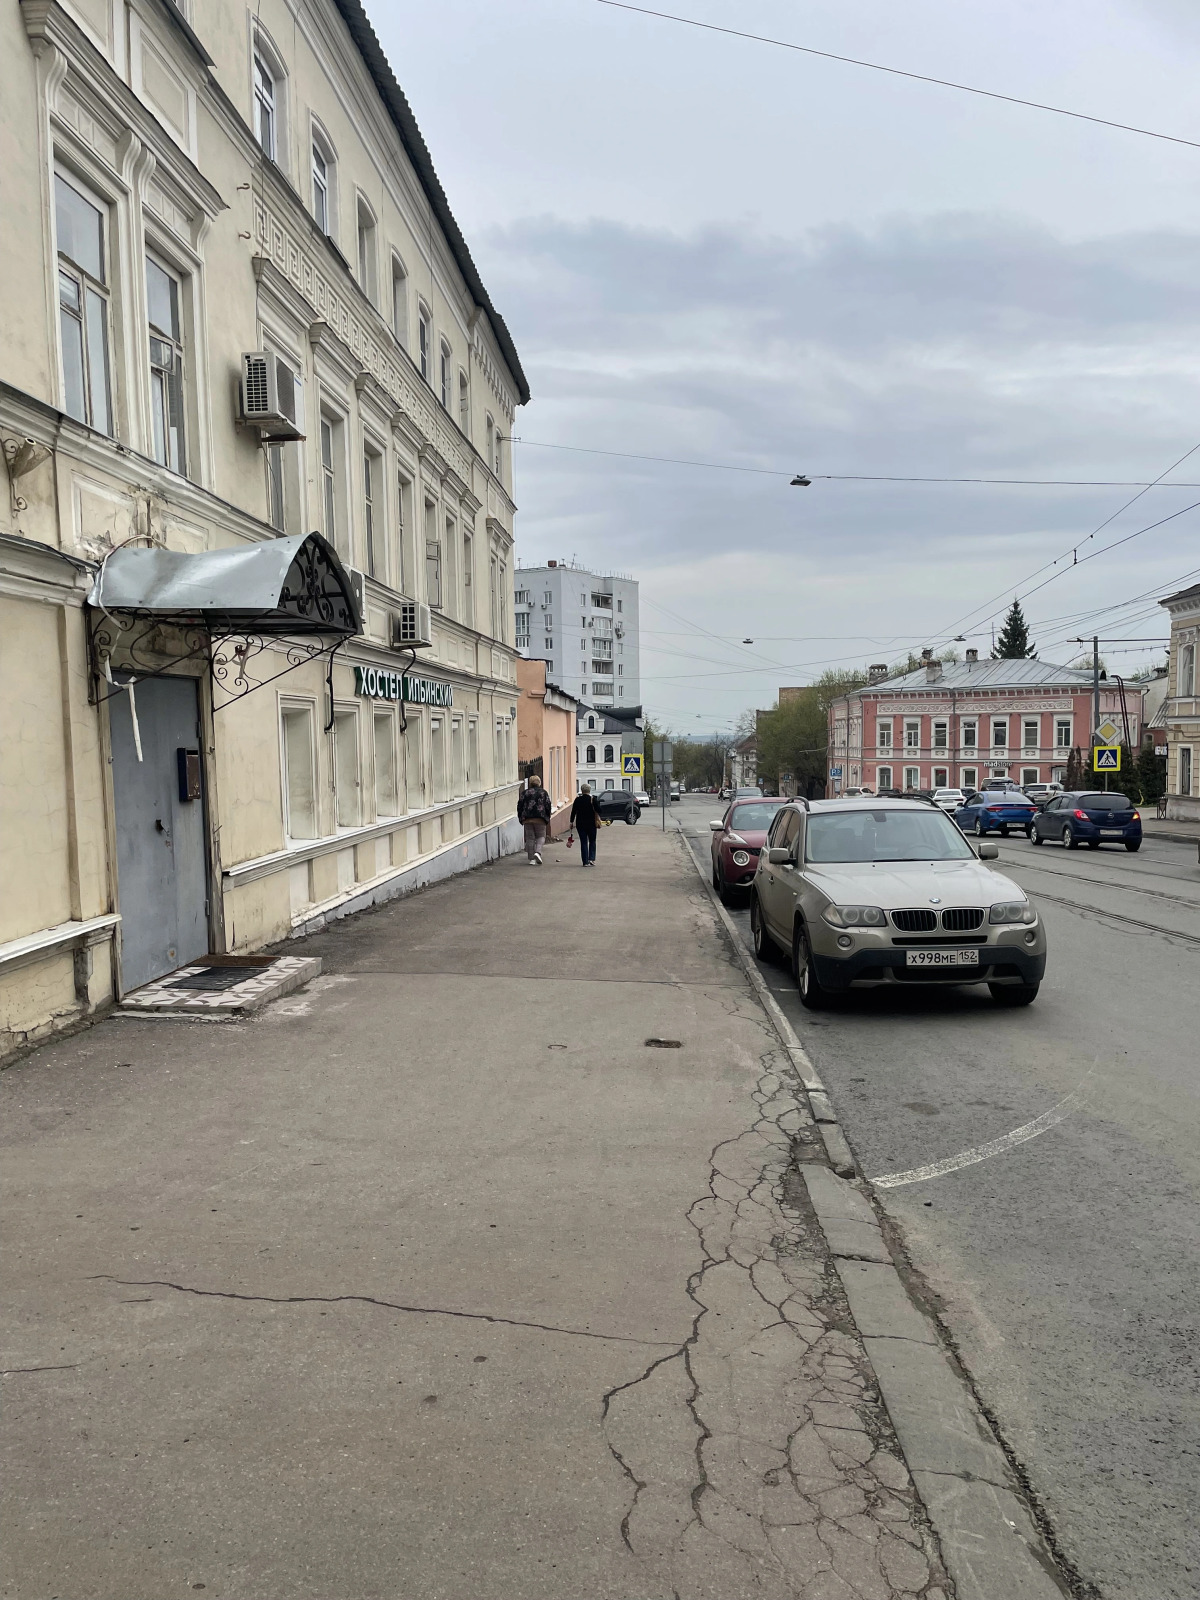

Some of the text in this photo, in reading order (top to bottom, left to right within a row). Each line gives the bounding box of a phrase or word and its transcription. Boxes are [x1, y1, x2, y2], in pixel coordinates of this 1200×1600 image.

[360, 666, 453, 706] ХОСТЕЛ ИЛЬИНСКИЙ
[959, 951, 975, 960] 152
